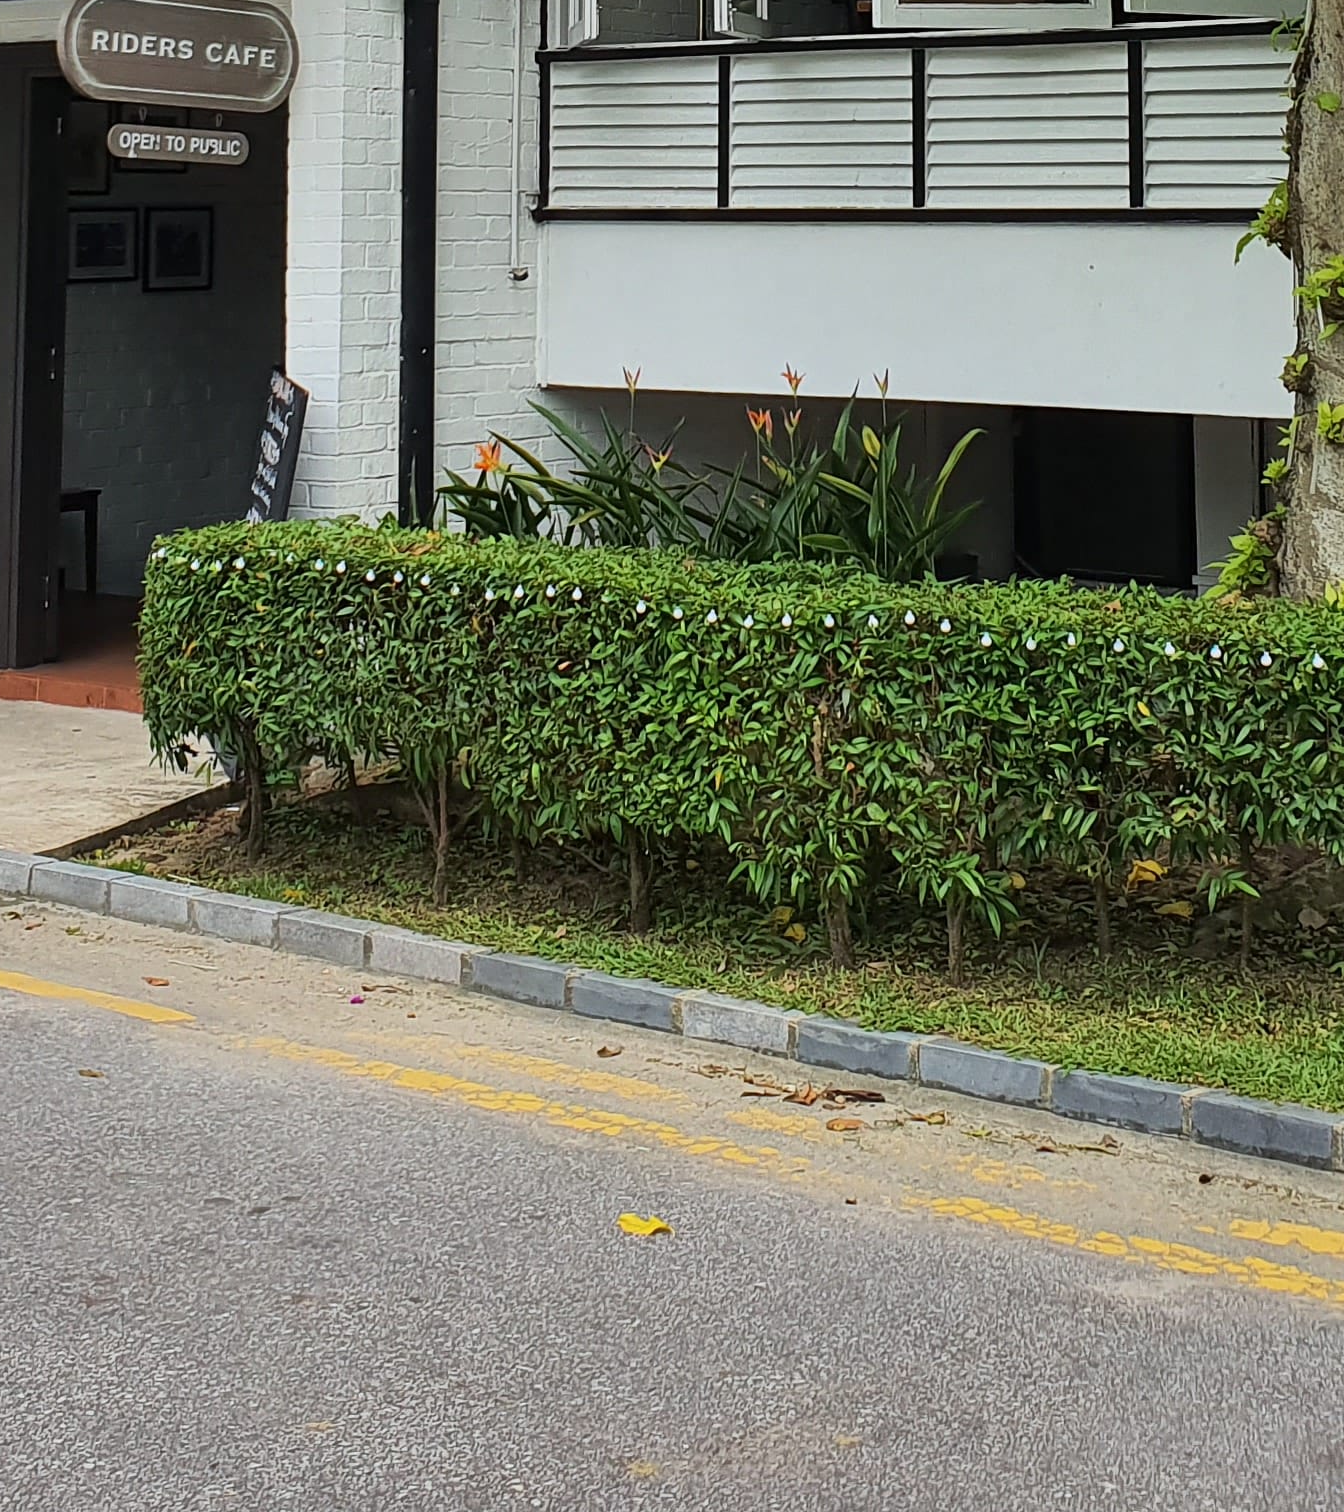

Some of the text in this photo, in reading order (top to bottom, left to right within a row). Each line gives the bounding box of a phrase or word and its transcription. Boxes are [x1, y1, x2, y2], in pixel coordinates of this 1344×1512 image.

[91, 30, 276, 68] RIDERS CAFE
[119, 132, 241, 156] OPEN TO PUBLIC
